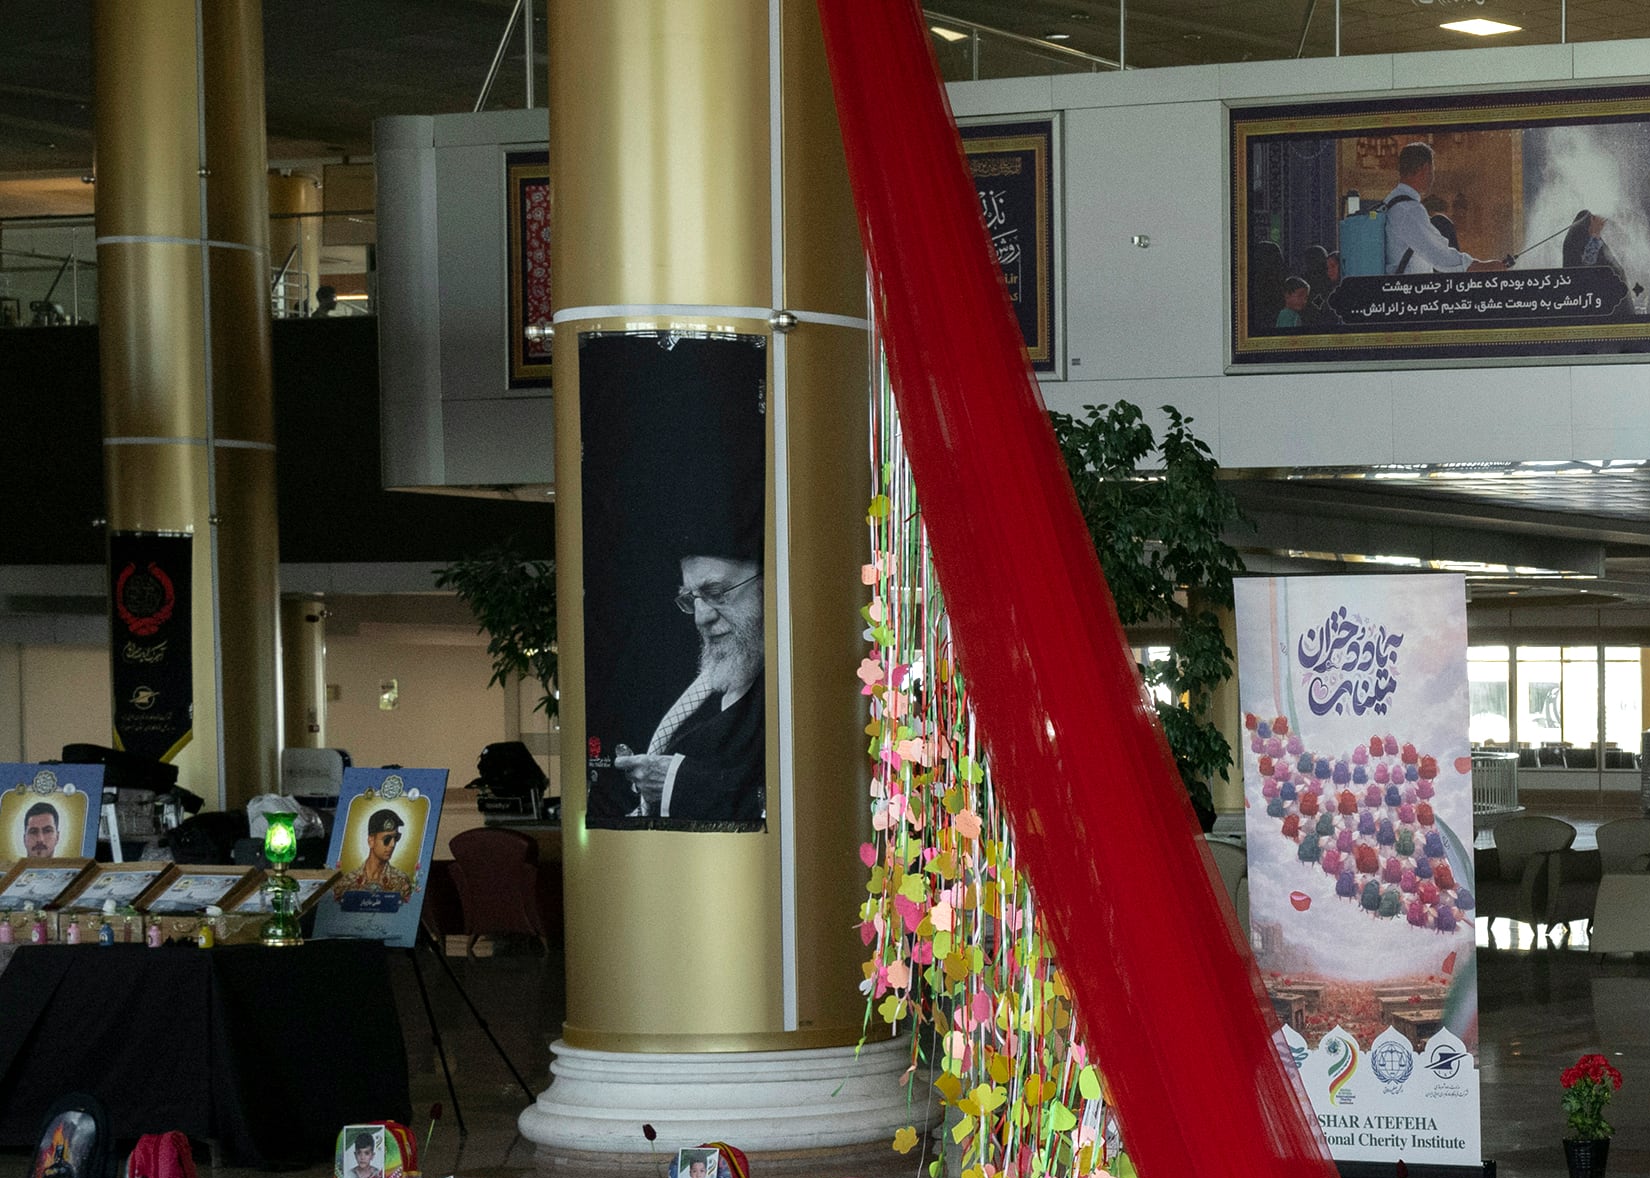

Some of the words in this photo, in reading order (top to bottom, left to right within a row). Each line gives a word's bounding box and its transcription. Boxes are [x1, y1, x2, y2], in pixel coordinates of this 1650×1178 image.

[1381, 281, 1413, 294] بهشت
[1414, 281, 1442, 294] جنس
[1443, 279, 1454, 293] از
[1455, 277, 1483, 293] عطری
[1484, 276, 1498, 290] که
[1499, 278, 1525, 291] بودم
[1527, 275, 1553, 291] کرده
[1553, 275, 1572, 291] نذر
[1406, 302, 1419, 315] به
[1419, 299, 1440, 314] کنم
[1440, 299, 1472, 314] تقدیم
[1504, 297, 1538, 312] وسعت
[1539, 297, 1553, 310] به
[1553, 293, 1594, 309] آرامشی
[1594, 297, 1602, 308] و
[1363, 1114, 1439, 1131] ATEFEHA
[1358, 1132, 1408, 1151] Cherity
[1411, 1134, 1466, 1150] Institute
